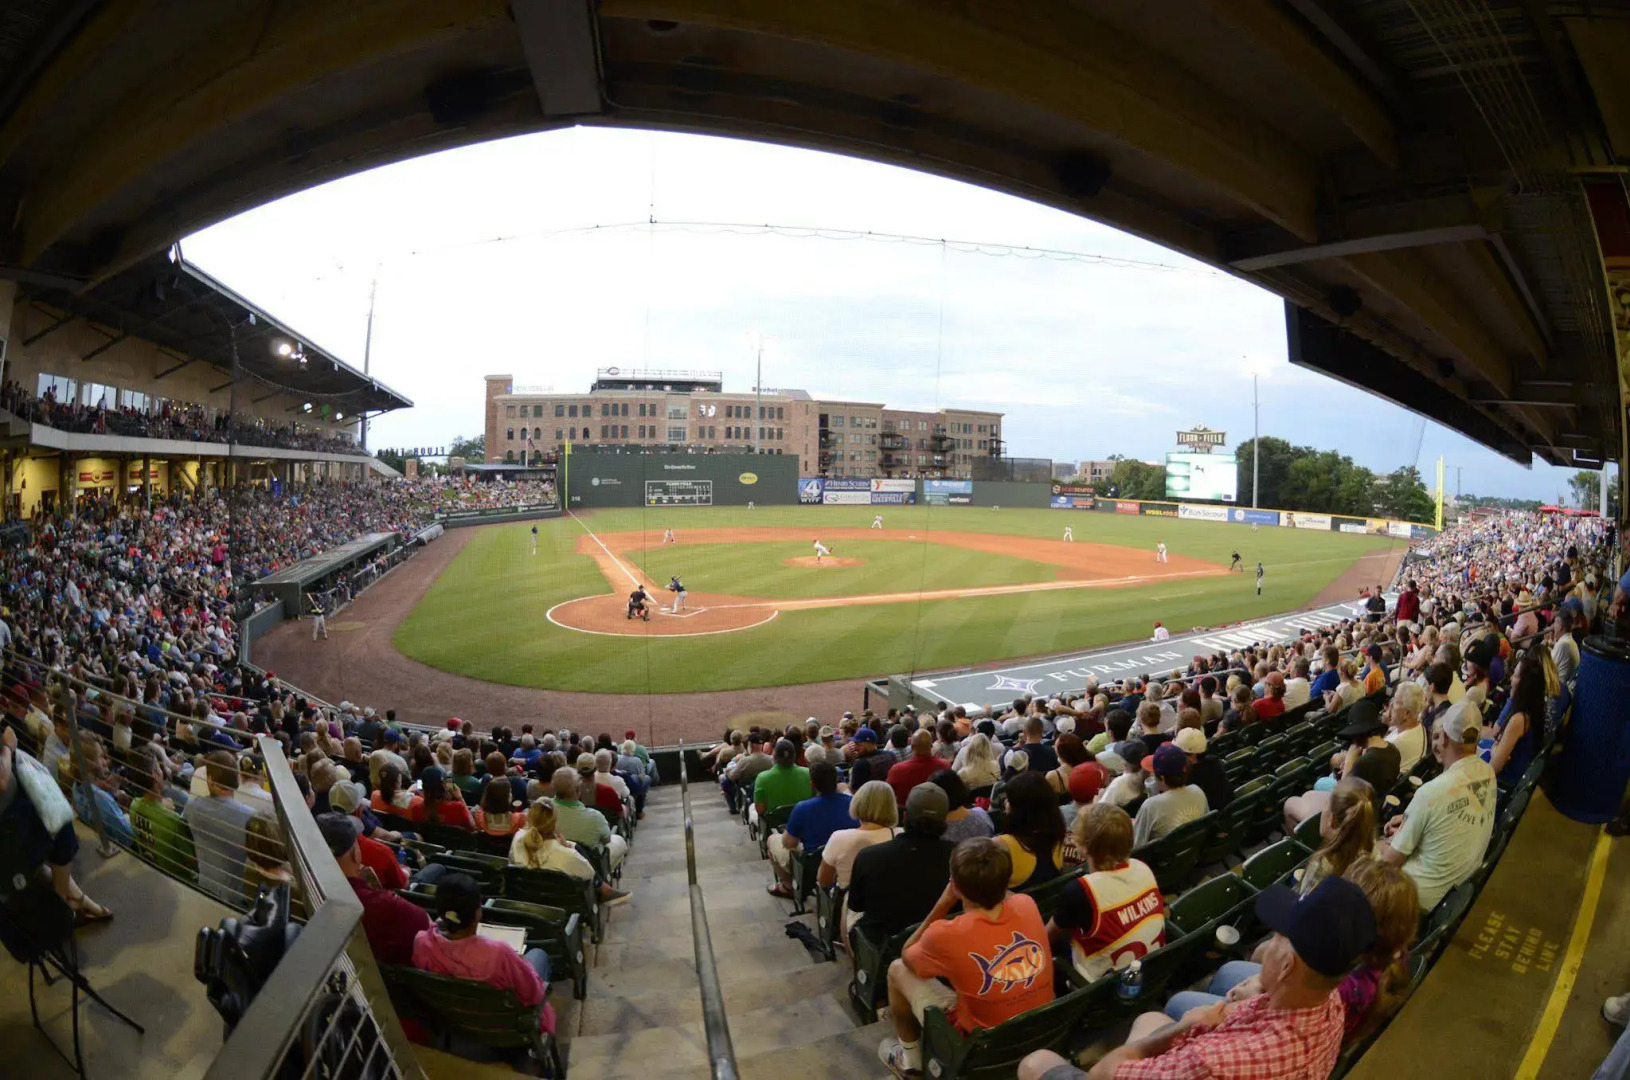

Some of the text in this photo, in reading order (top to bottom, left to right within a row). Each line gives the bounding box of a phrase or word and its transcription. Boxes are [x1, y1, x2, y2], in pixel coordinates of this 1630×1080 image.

[1179, 433, 1223, 443] FLUOR FIELD
[1188, 508, 1227, 518] Bon Secours
[1045, 650, 1184, 682] FURMAN
[1117, 892, 1160, 926] WILKINS
[1468, 911, 1505, 959] PLEASE
[1494, 925, 1521, 960] STAY
[1511, 927, 1543, 975] BEHIND
[1536, 941, 1559, 971] LINE
